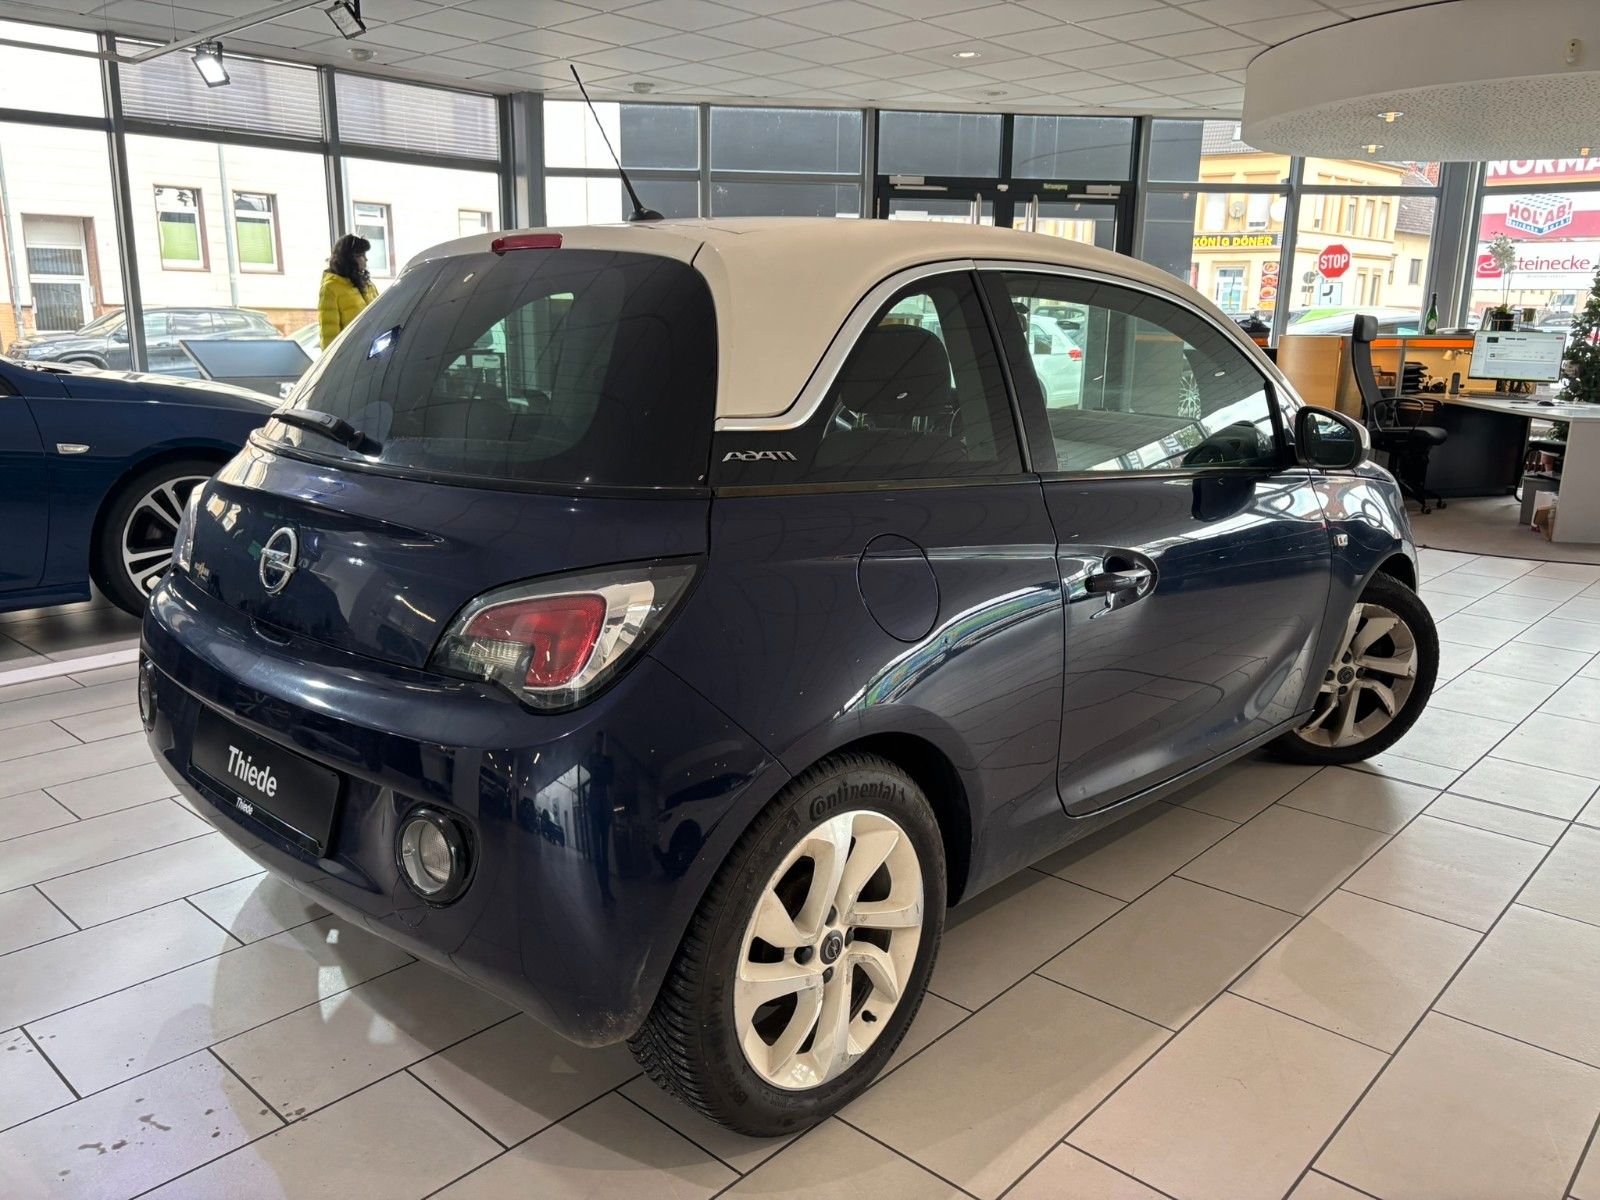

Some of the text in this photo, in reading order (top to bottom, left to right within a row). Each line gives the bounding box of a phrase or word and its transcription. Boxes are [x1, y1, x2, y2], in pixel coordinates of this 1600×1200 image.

[1232, 235, 1273, 247] DÖNER
[1320, 253, 1349, 270] STOP
[227, 744, 278, 798] Thiede
[235, 796, 254, 816] Thiede
[808, 779, 898, 823] Continental
